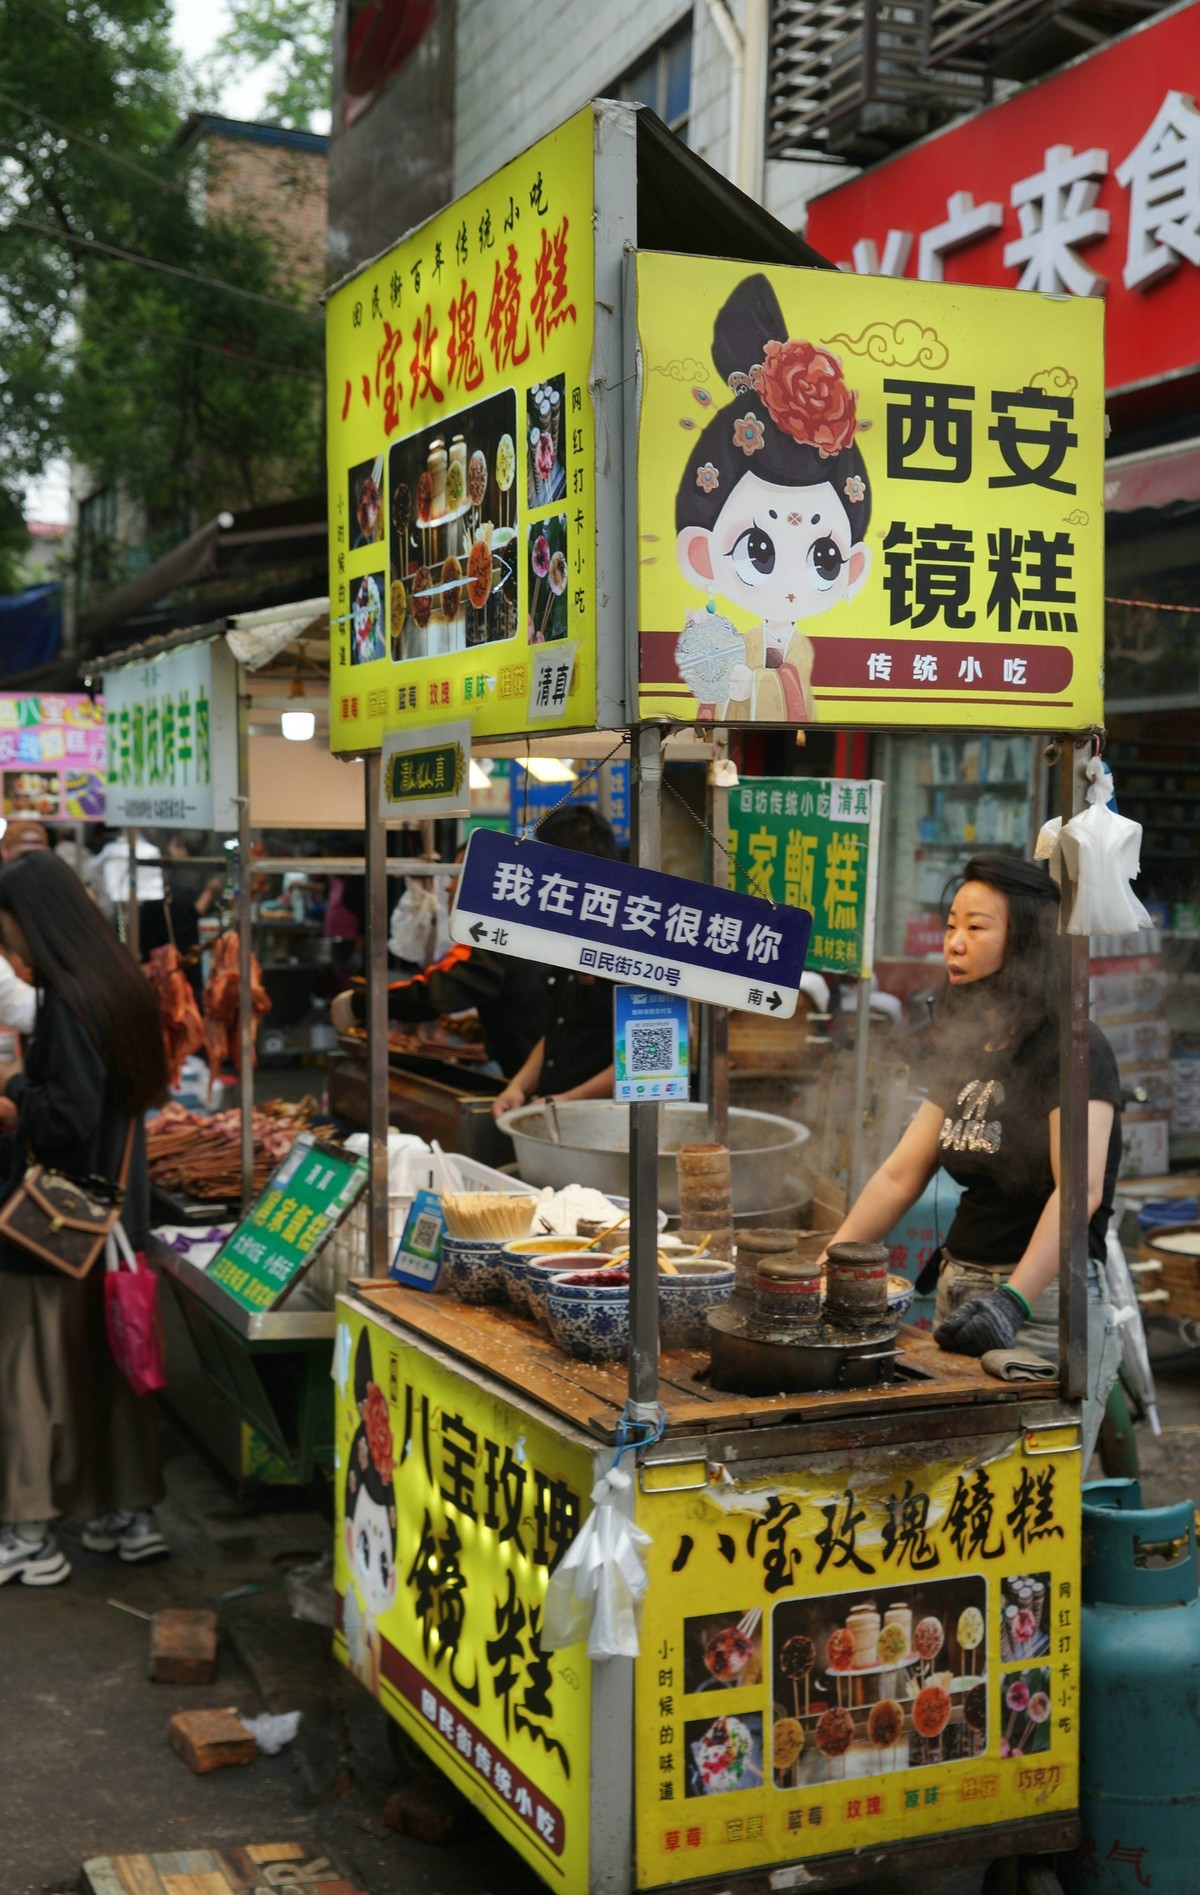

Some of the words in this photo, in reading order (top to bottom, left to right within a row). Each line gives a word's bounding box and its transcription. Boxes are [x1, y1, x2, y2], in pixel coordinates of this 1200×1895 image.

[341, 215, 577, 437] 八宝玫瑰镜糕
[883, 378, 1078, 495] 西安
[571, 386, 586, 614] 网红打卡小吃
[883, 521, 1078, 633] 镜糕
[536, 663, 570, 707] 清真
[867, 653, 1027, 685] 传统小吃
[740, 789, 830, 818] 回坊传统小吃
[838, 786, 868, 816] 清真
[491, 862, 784, 964] 我在西安很想你
[491, 928, 508, 946] 北
[814, 935, 858, 962] 真材实料
[579, 948, 682, 986] 回民街520号
[747, 988, 764, 1006] 南
[672, 1464, 1064, 1593] 八宝玫瑰镜糕
[406, 1508, 570, 1781] 镜糕
[1058, 1581, 1072, 1734] 网红打卡小吃
[658, 1640, 674, 1801] 小时候的味道
[664, 1827, 701, 1852] 草莓
[788, 1805, 823, 1831] 蓝莓
[847, 1796, 882, 1818] 玫瑰
[904, 1786, 939, 1808] 原味
[1017, 1765, 1061, 1789] 巧克力
